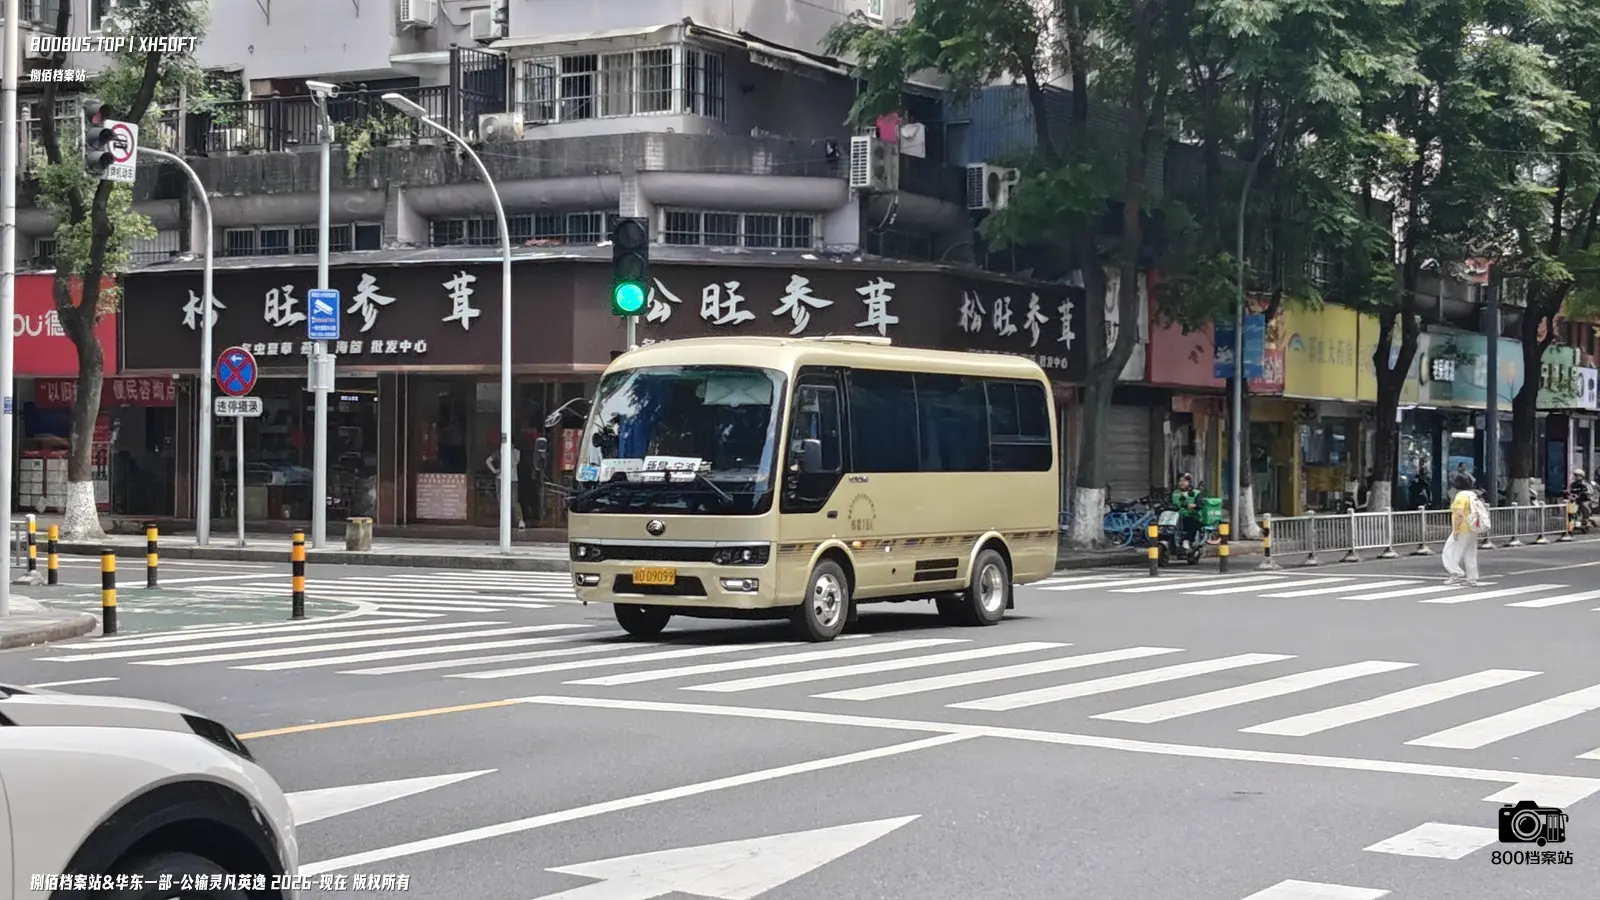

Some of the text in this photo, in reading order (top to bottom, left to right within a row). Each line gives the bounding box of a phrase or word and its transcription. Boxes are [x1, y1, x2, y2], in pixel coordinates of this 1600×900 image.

[957, 290, 1076, 352] 松旺参茸
[370, 339, 428, 354] 批发中心
[217, 400, 259, 413] 违停摄录
